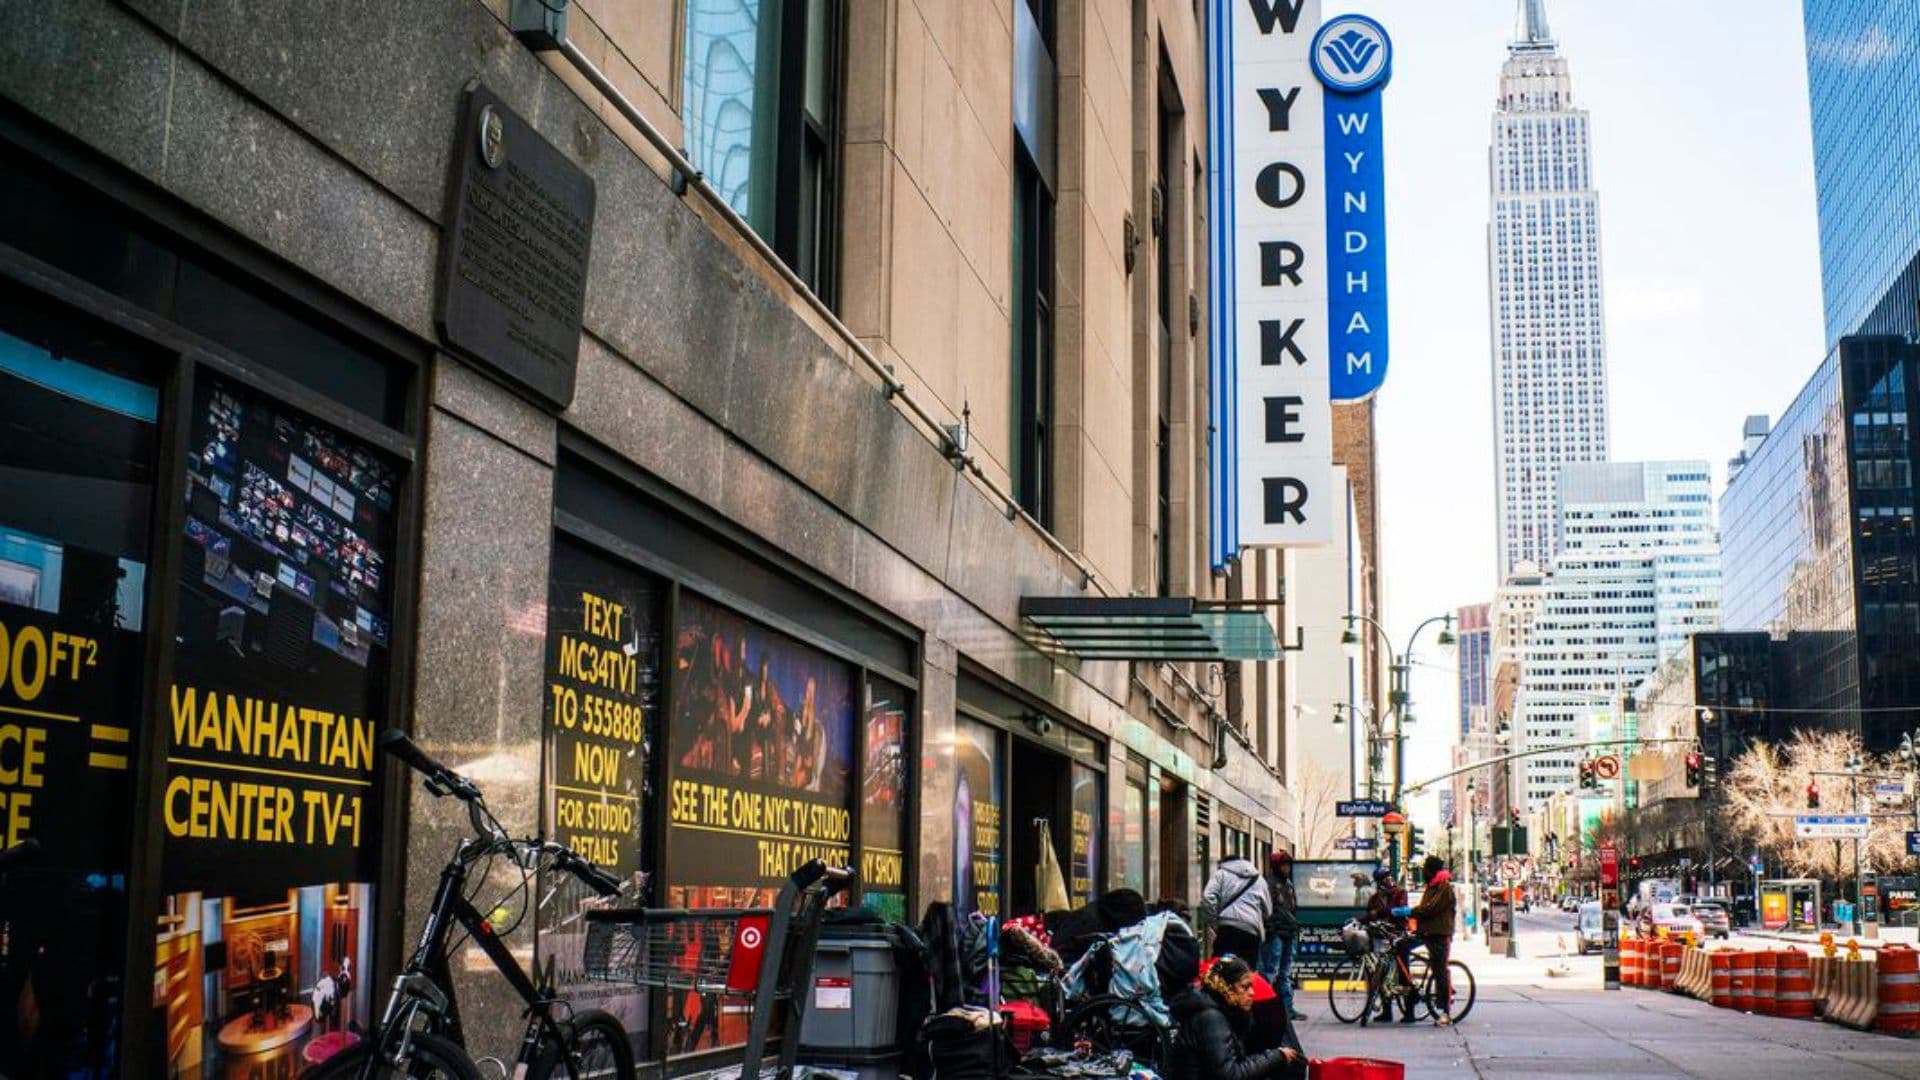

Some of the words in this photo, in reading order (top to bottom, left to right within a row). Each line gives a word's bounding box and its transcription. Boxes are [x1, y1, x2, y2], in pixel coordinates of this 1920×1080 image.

[1337, 112, 1373, 376] WYNDHAM
[1255, 86, 1309, 525] YORKER
[582, 592, 624, 642] TEXT
[559, 635, 638, 696] MC34TV1
[170, 684, 375, 771] MANHATTAN
[552, 683, 578, 729] TO
[582, 695, 643, 743] 555888
[574, 742, 621, 788] NOW
[163, 775, 294, 844] CENTER
[302, 789, 362, 848] TV-1
[557, 797, 587, 829] FOR
[588, 802, 632, 834] STUDIO
[671, 779, 699, 827] SEE
[702, 783, 730, 831] THE
[731, 788, 762, 834] ONE
[764, 793, 791, 838] NYC
[792, 799, 809, 841] TV
[810, 805, 851, 844] STUDIO
[1341, 804, 1367, 813] Eighth
[1370, 804, 1385, 812] Ave
[570, 836, 619, 866] DETAILS
[758, 840, 790, 877] THAT
[876, 857, 902, 885] SHOW
[1889, 890, 1916, 899] PARK
[1299, 933, 1319, 942] Penn
